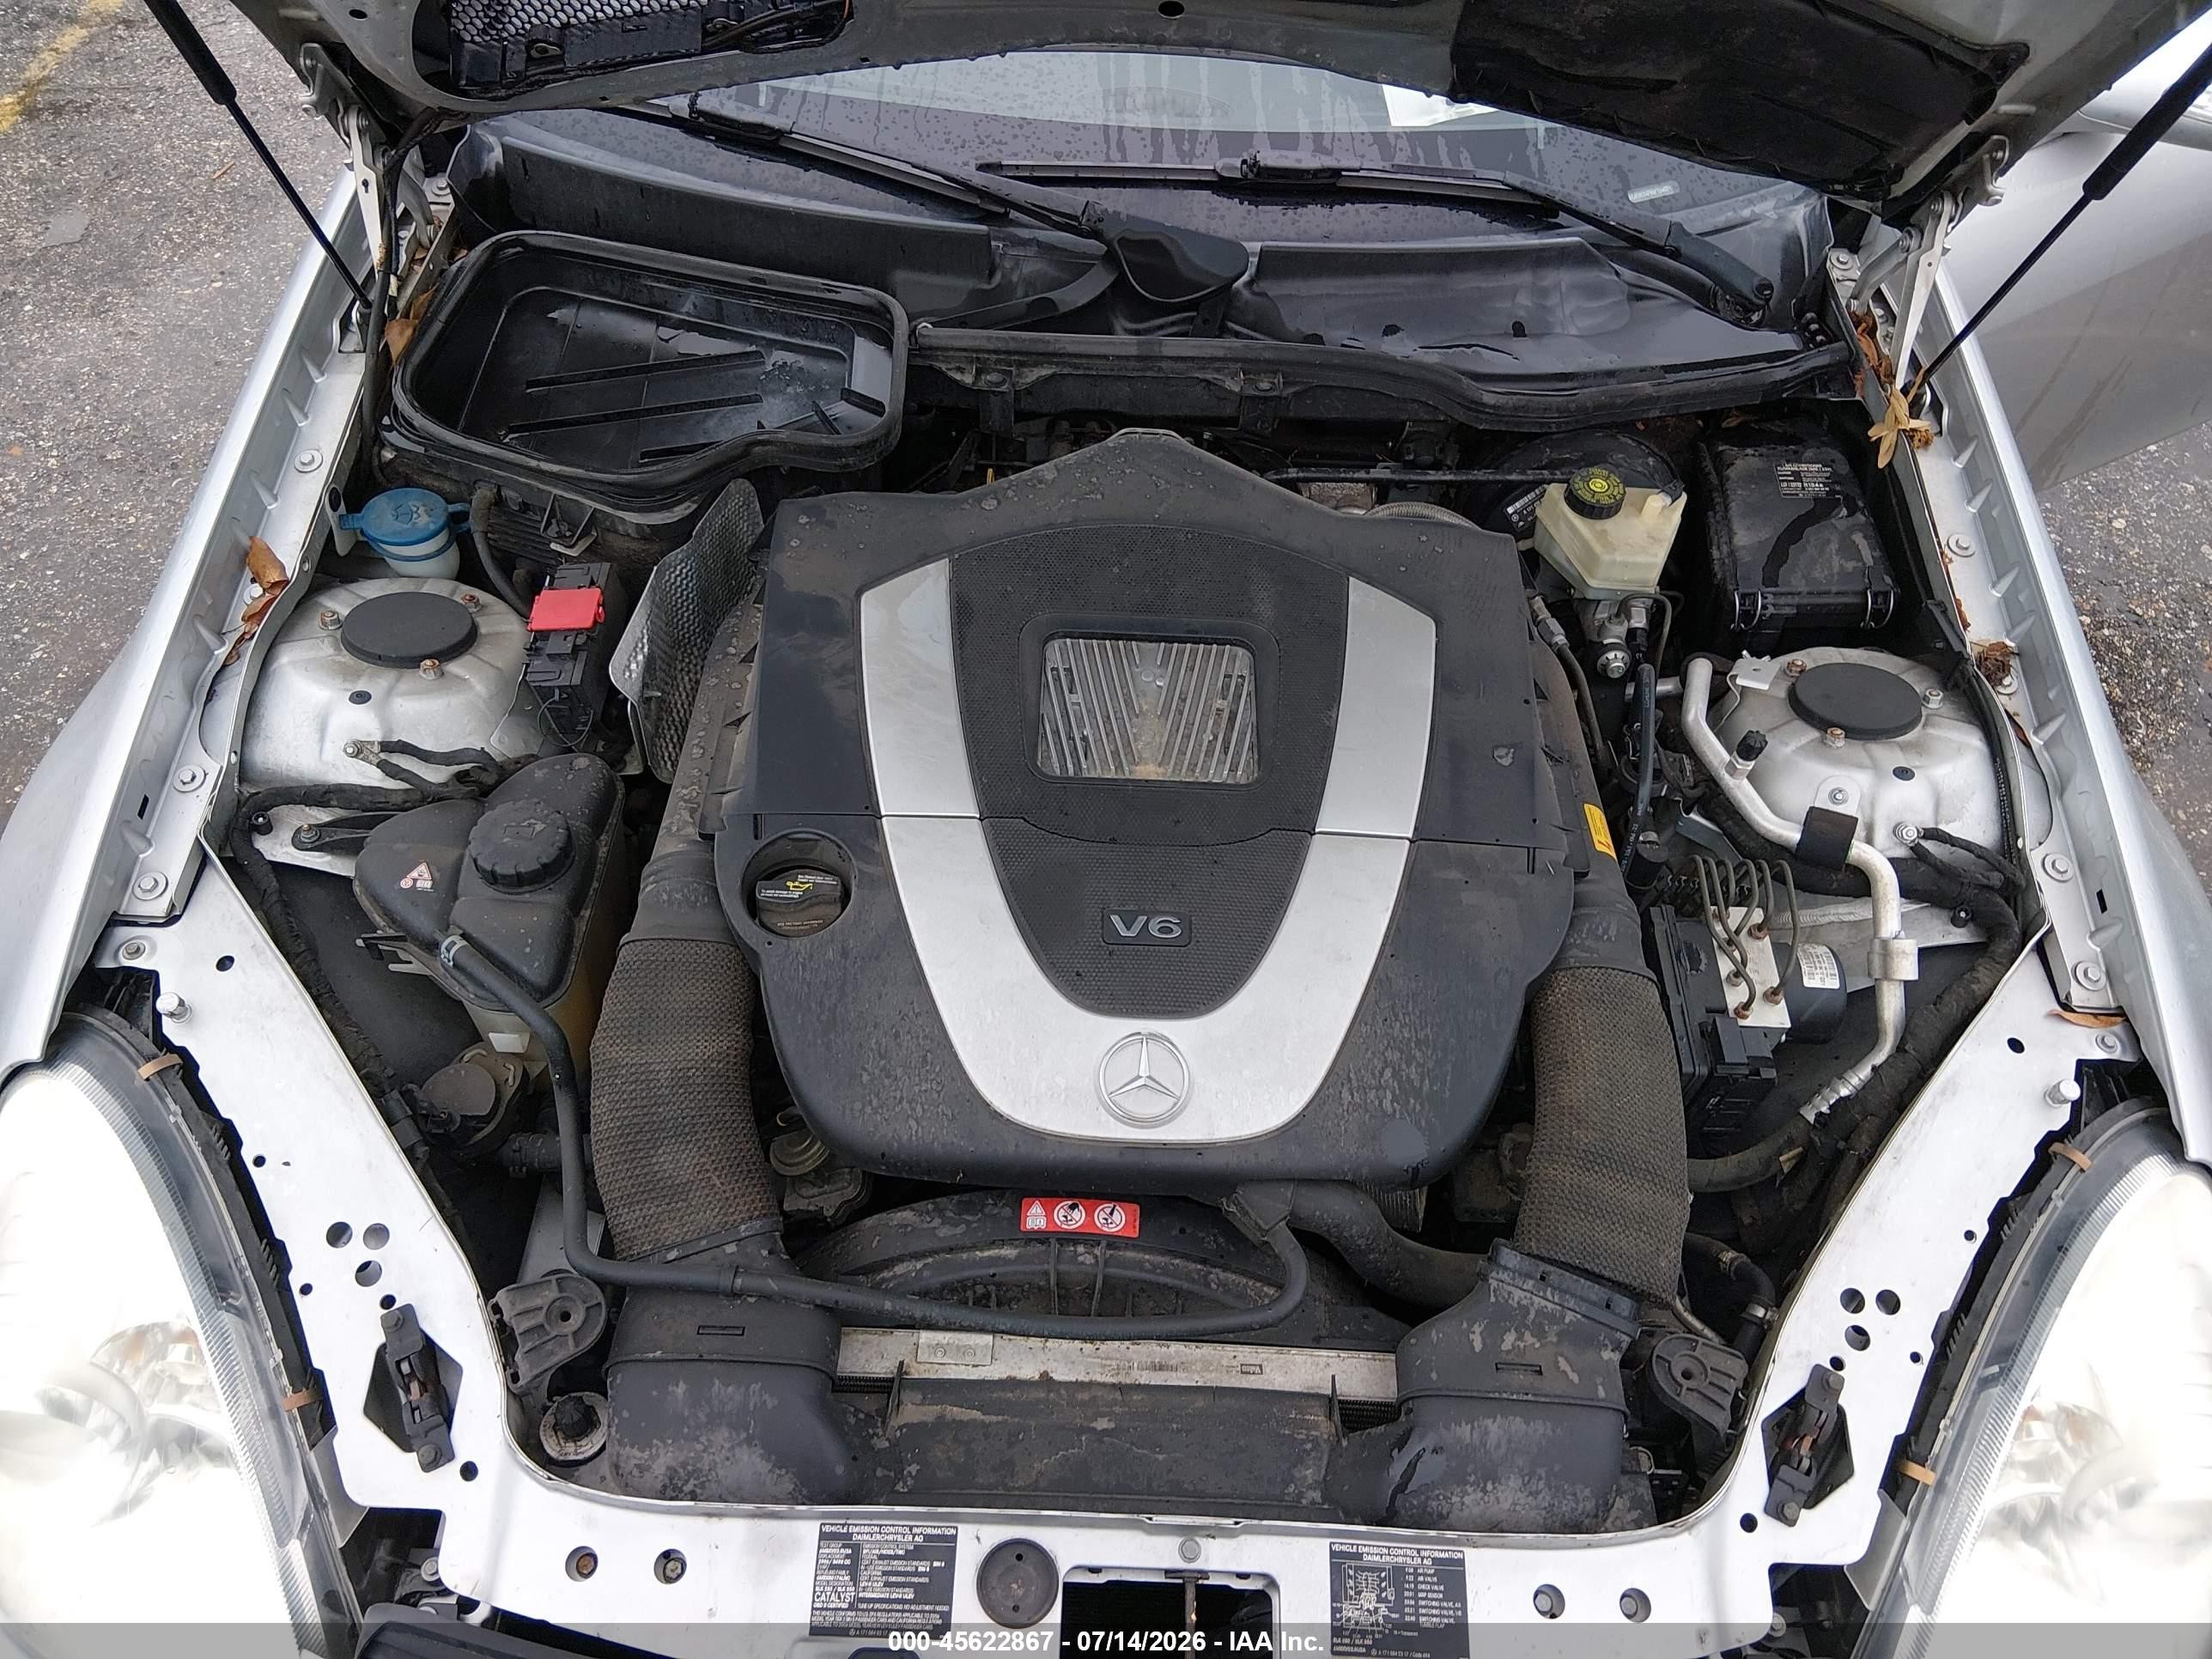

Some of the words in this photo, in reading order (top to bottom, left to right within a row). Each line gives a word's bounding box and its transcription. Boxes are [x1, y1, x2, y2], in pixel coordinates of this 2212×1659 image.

[1109, 915, 1182, 939] V6
[848, 1525, 879, 1534] EMISSION
[881, 1526, 910, 1534] CONTROL
[912, 1527, 956, 1535] INFORMATION
[1358, 1546, 1389, 1554] EMISSION
[1389, 1547, 1419, 1557] CONTROL
[1420, 1549, 1463, 1559] INFORMATION
[1363, 1554, 1421, 1564] DAIMLERCHRYSLER
[814, 1592, 855, 1602] CATALYST
